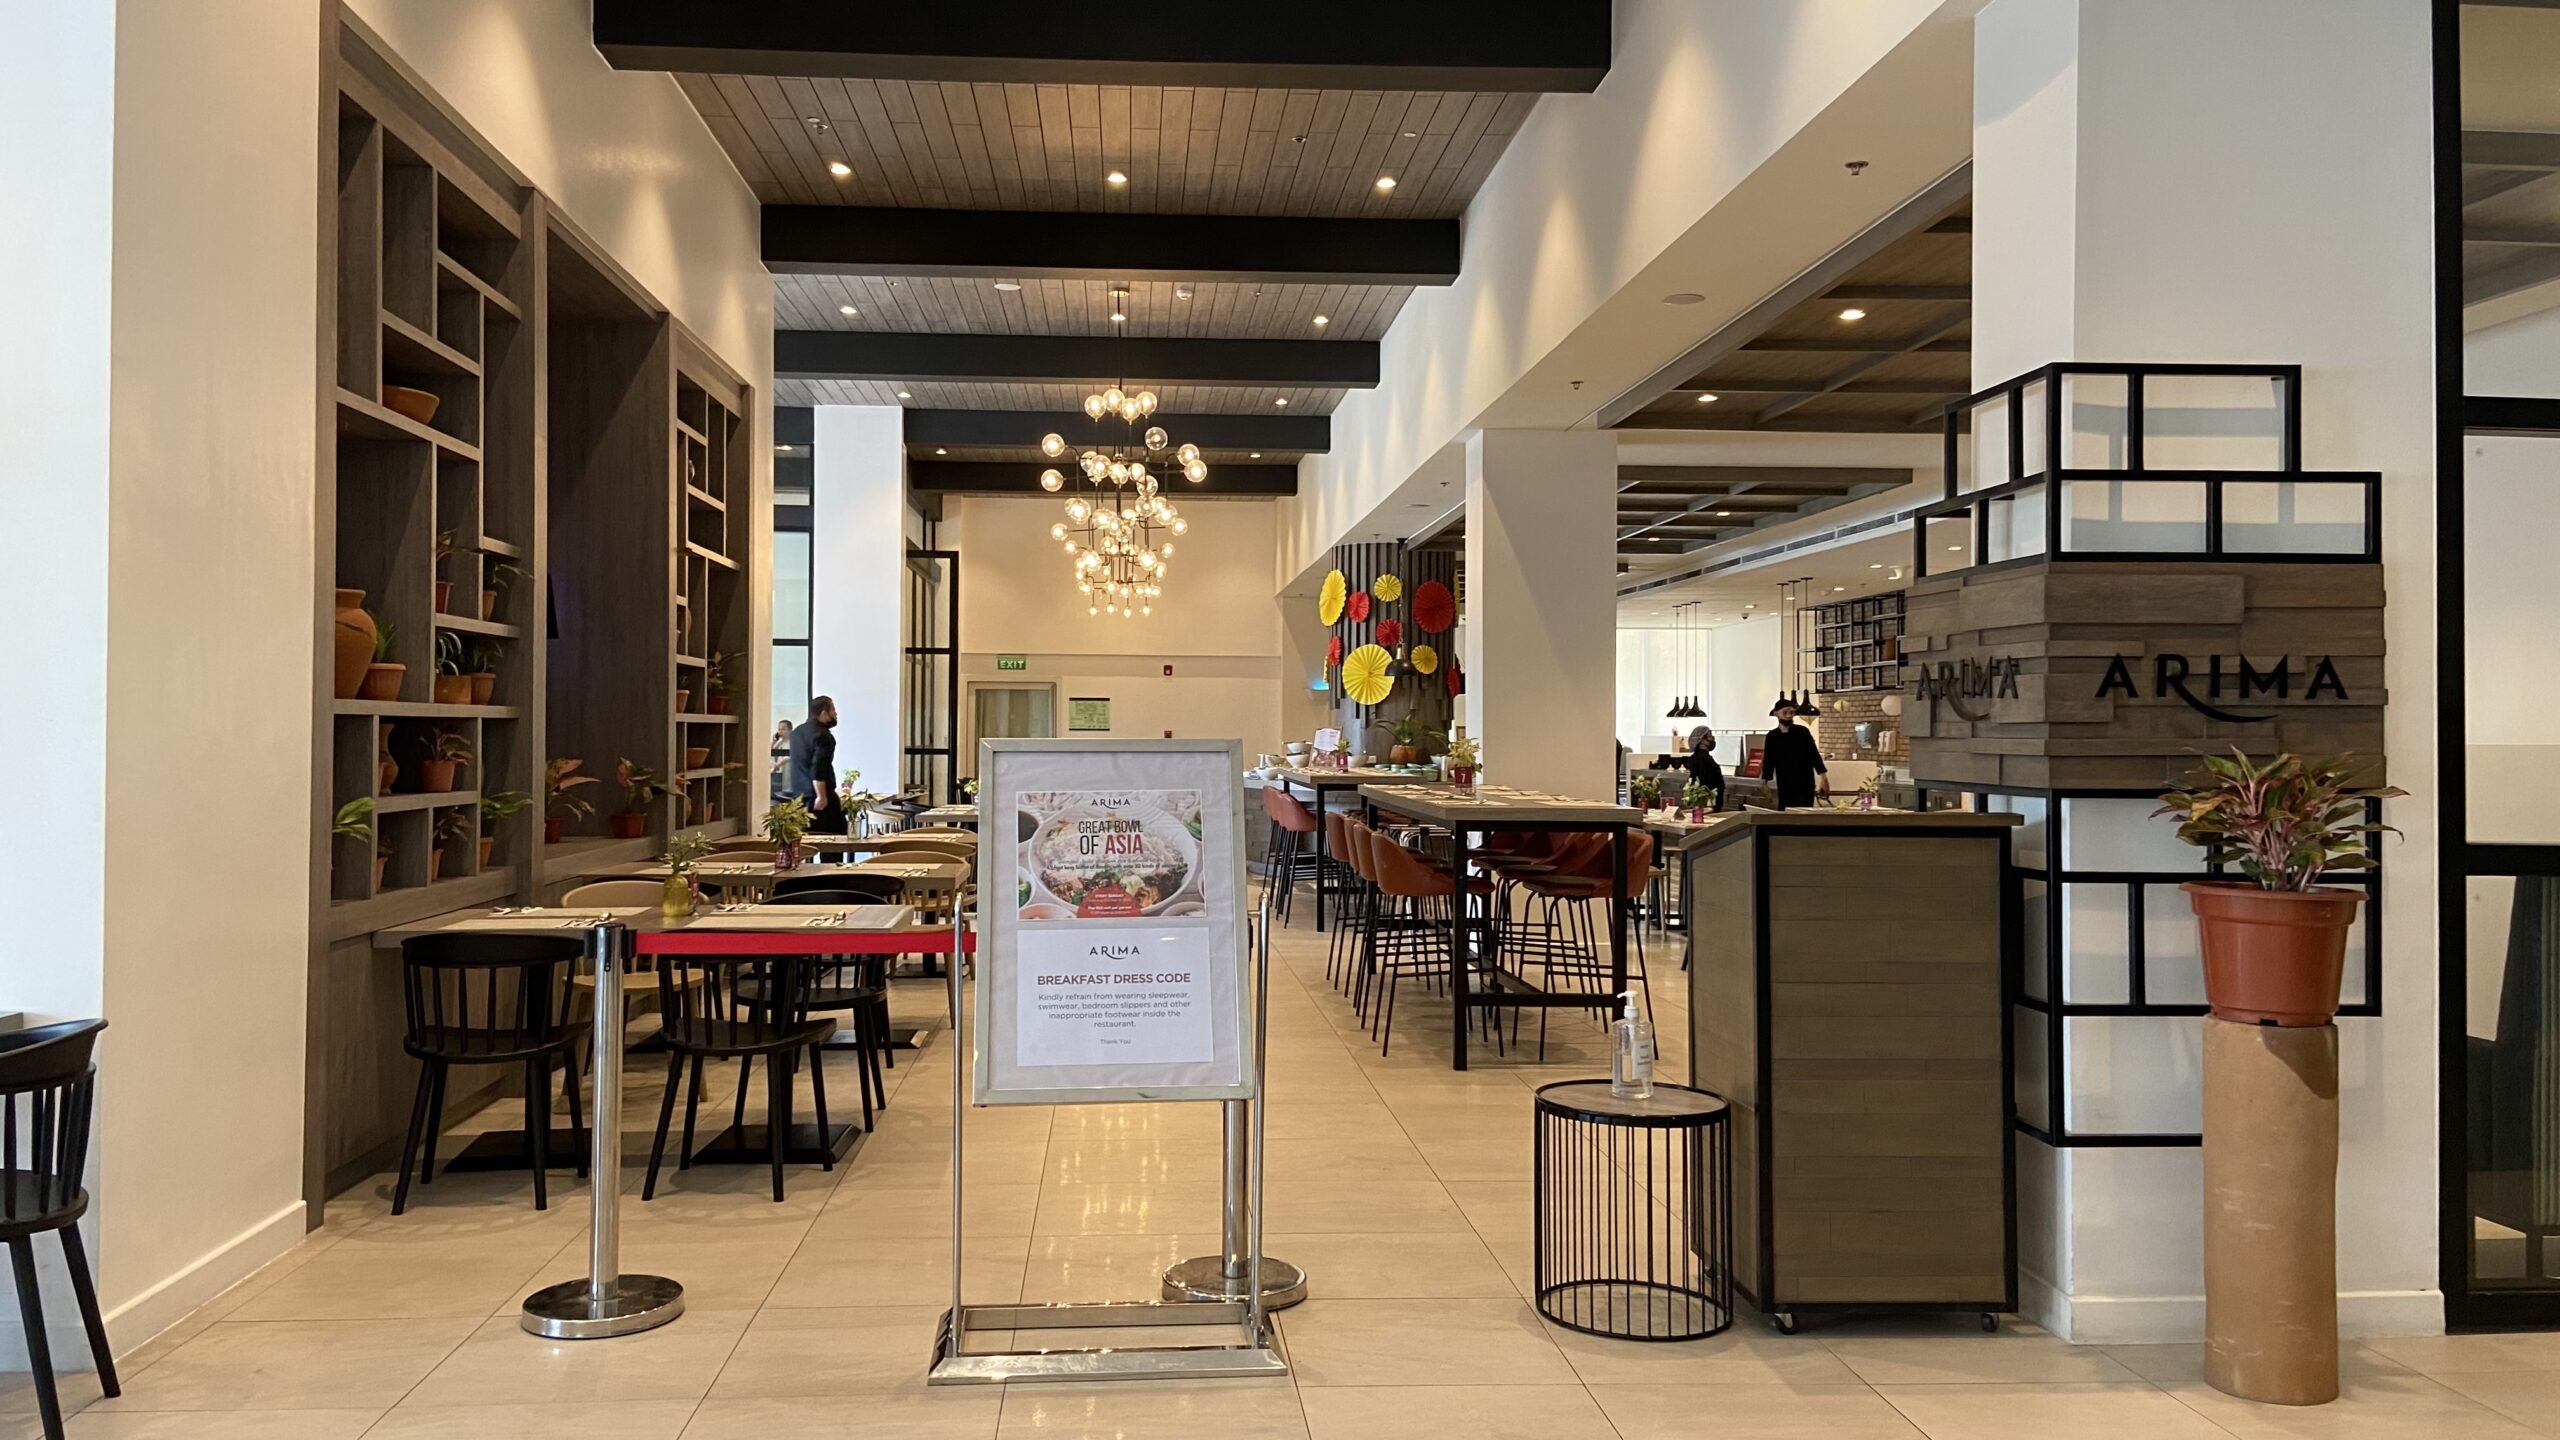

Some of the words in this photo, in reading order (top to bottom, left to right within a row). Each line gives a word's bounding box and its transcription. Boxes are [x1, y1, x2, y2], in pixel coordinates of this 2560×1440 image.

[1000, 660, 1025, 669] EXIT
[1916, 655, 2020, 722] ARIMA
[2094, 653, 2350, 723] ARIMA
[1460, 773, 1466, 783] 7
[1091, 798, 1131, 810] ARIMA
[1078, 820, 1112, 834] GREAT
[1114, 819, 1144, 833] BOWL
[1080, 834, 1099, 855] OF
[1104, 833, 1144, 855] ASIA
[1089, 945, 1140, 960] ARIMA
[1037, 974, 1111, 986] BREAKFAST
[1114, 973, 1154, 984] DRESS
[1156, 972, 1192, 983] CODE
[1038, 993, 1063, 1002] Kindly
[1065, 992, 1092, 1001] refrain
[1093, 991, 1113, 1000] from
[1115, 992, 1147, 1000] wearing
[1148, 991, 1191, 999] sleepwear,
[1082, 1002, 1119, 1010] bedroom
[1120, 1001, 1151, 1009] slippers
[1169, 1000, 1192, 1008] other
[1048, 1012, 1103, 1020] inappropriate
[1104, 1010, 1141, 1018] footwear
[1142, 1010, 1166, 1018] inside
[1167, 1009, 1181, 1017] the
[1093, 1020, 1137, 1028] restaurant.
